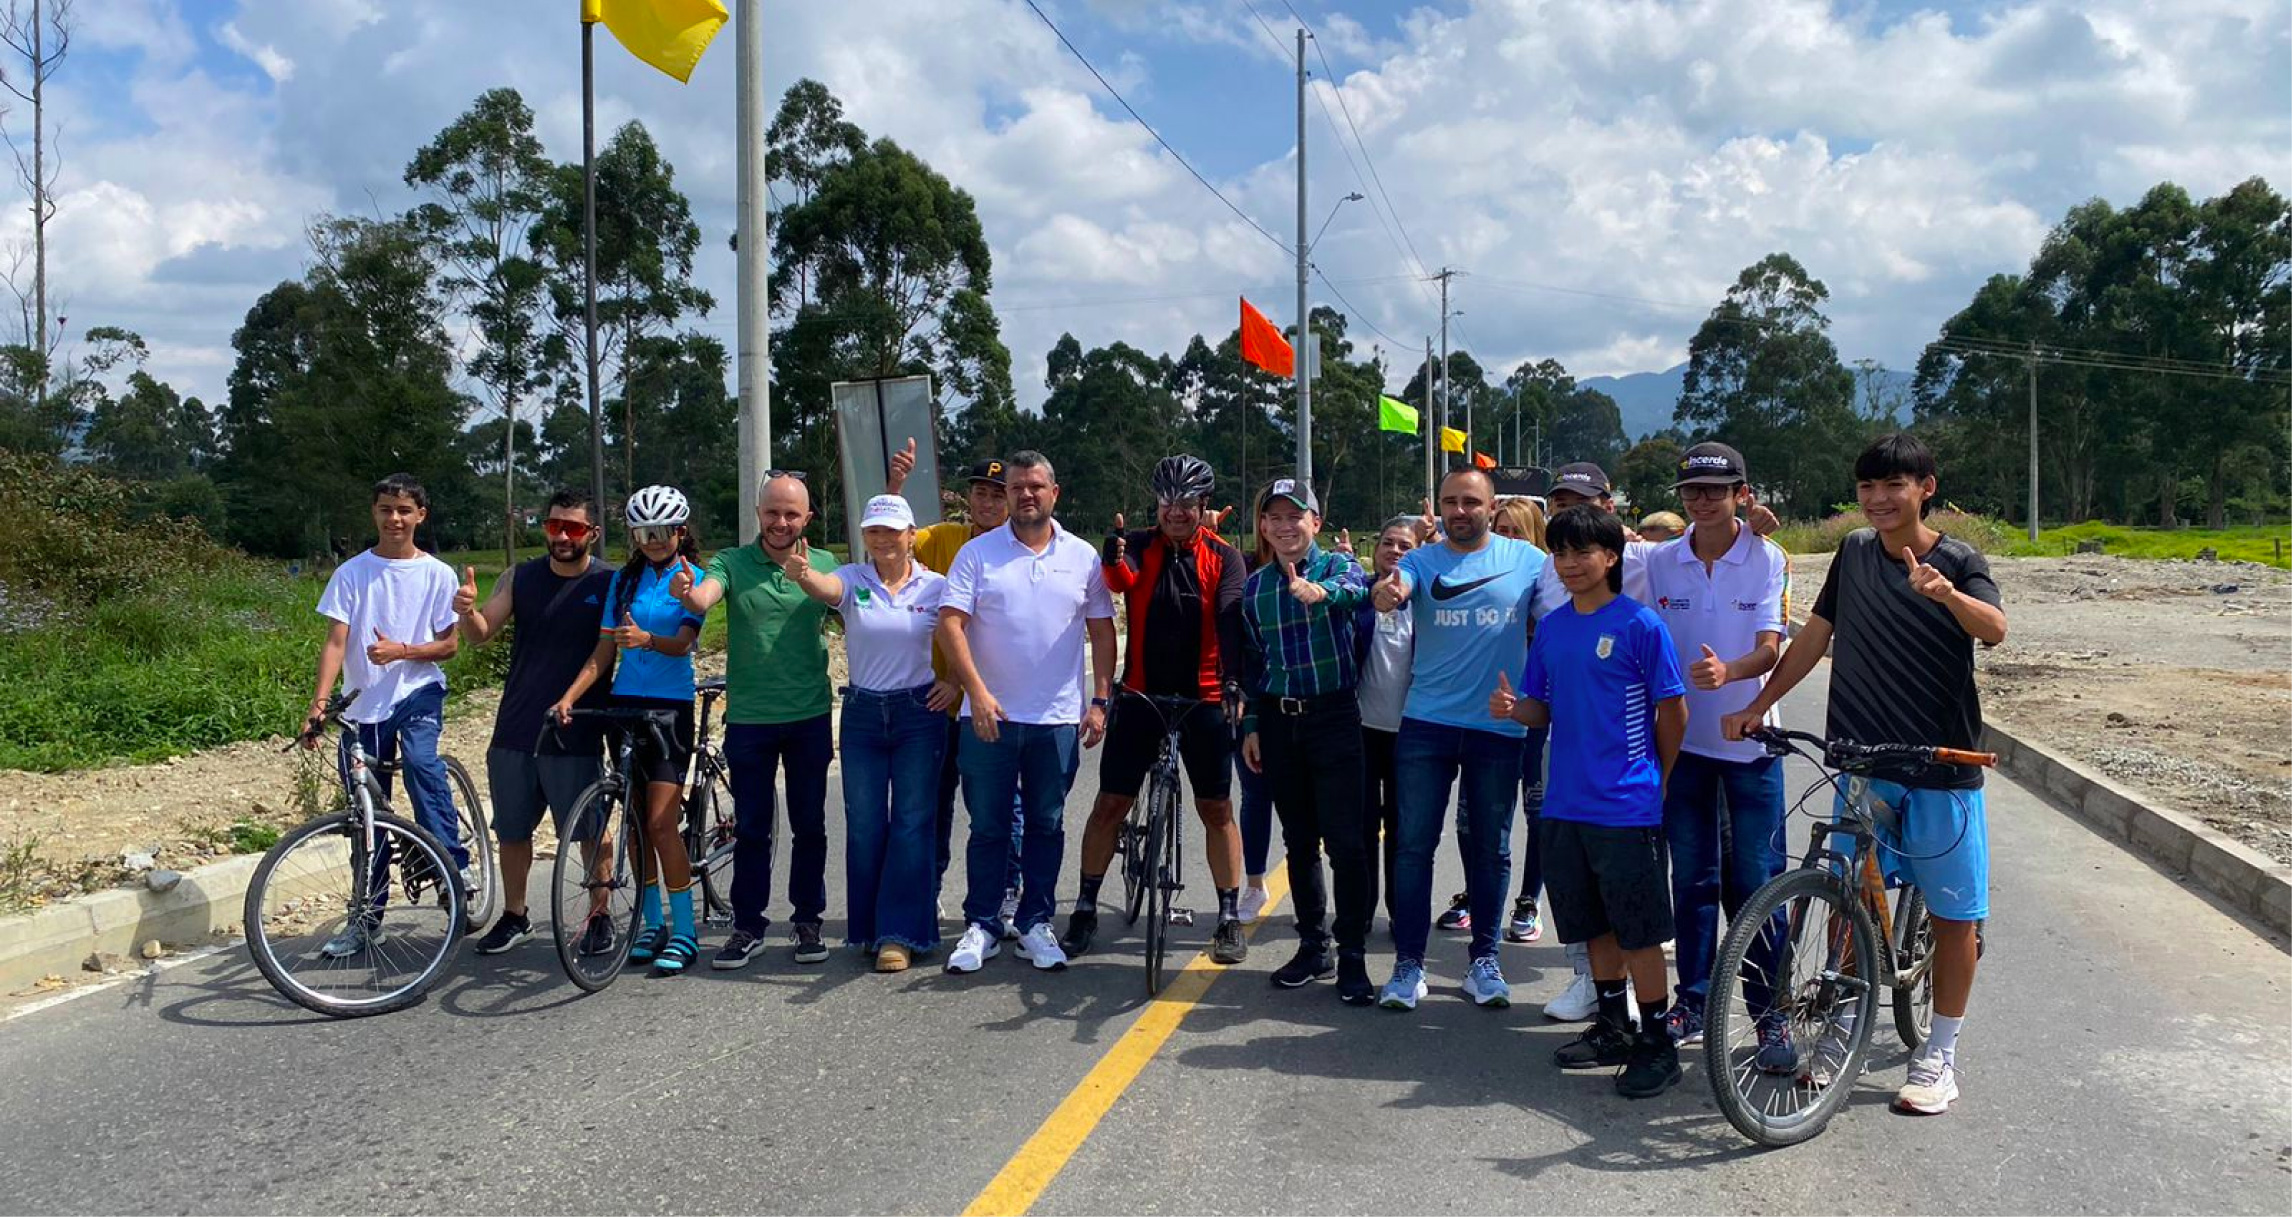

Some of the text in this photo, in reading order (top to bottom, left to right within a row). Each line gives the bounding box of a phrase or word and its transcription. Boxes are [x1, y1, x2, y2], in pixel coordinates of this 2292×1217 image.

[987, 462, 1002, 477] P
[1434, 608, 1469, 626] JUST
[1475, 607, 1499, 626] DO
